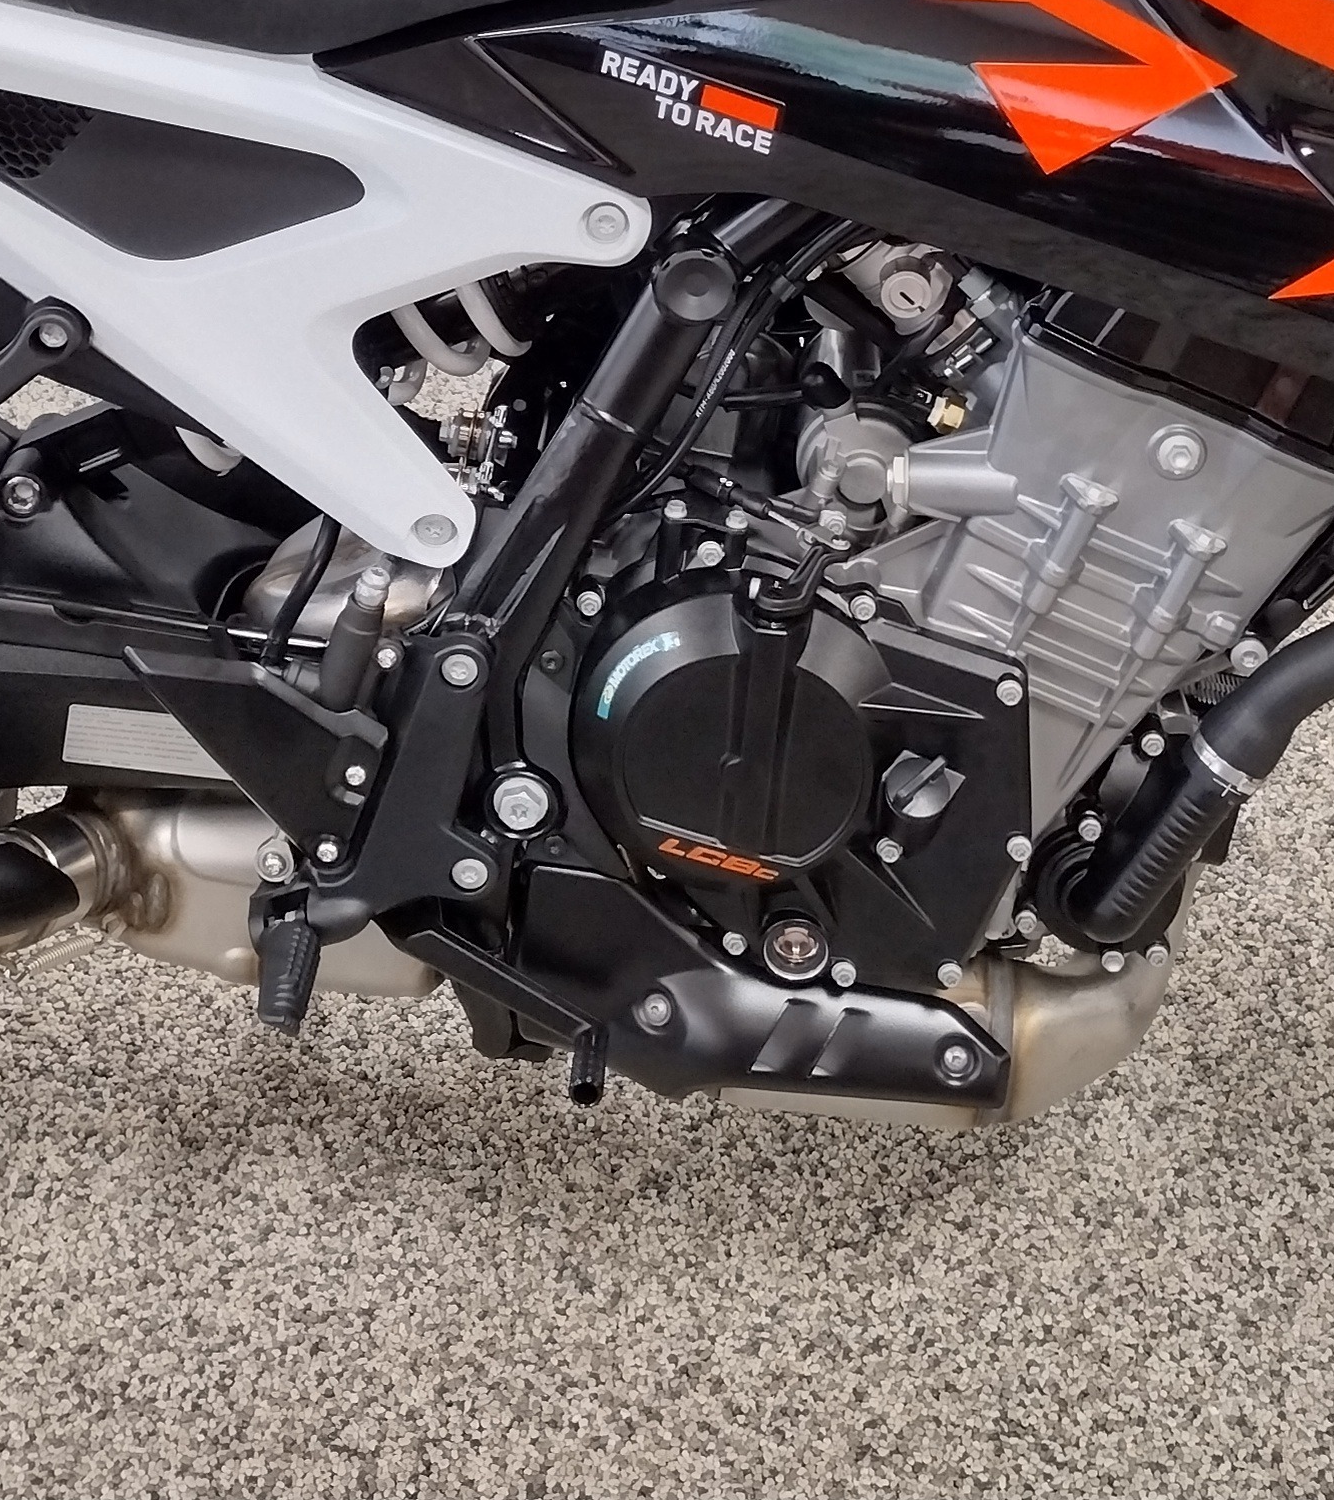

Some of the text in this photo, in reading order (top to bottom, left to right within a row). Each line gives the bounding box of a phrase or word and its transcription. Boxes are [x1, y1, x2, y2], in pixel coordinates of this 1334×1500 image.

[600, 50, 700, 101] READY
[655, 94, 774, 155] TO RACE
